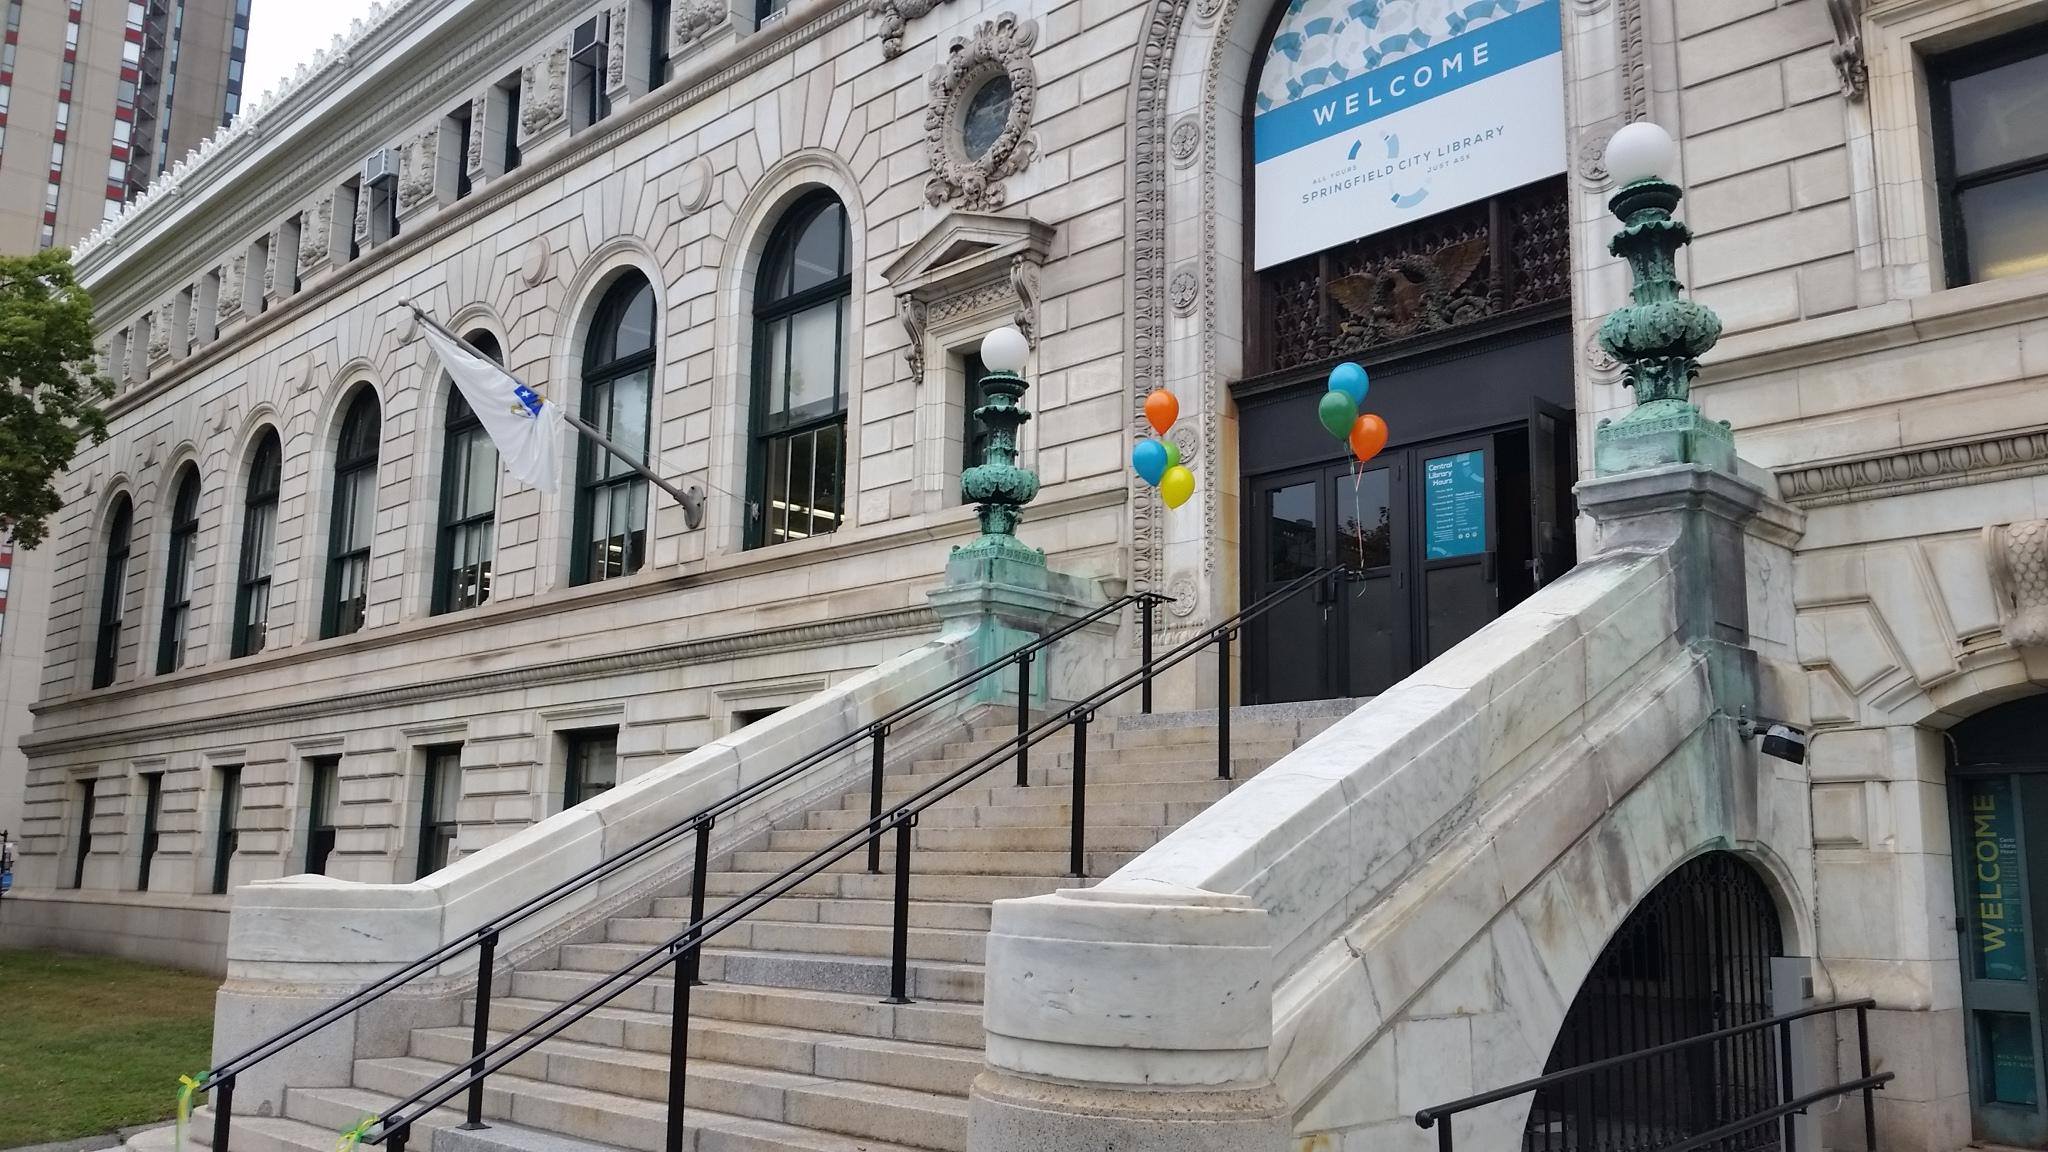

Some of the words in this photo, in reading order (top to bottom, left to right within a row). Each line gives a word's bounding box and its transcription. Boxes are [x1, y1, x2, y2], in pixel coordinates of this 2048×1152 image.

[1313, 42, 1489, 126] WELCOME
[1302, 165, 1394, 204] SPRINGFIELD
[1398, 151, 1431, 170] CITY
[1437, 125, 1505, 157] LIBRARY
[1427, 160, 1449, 173] JUST
[1453, 154, 1471, 164] ASK
[1312, 176, 1327, 185] ALL
[1330, 164, 1357, 178] YOURS
[1428, 461, 1453, 471] Central
[1428, 470, 1453, 479] Library
[1432, 478, 1453, 487] Hours
[1973, 794, 2007, 953] WELCOME
